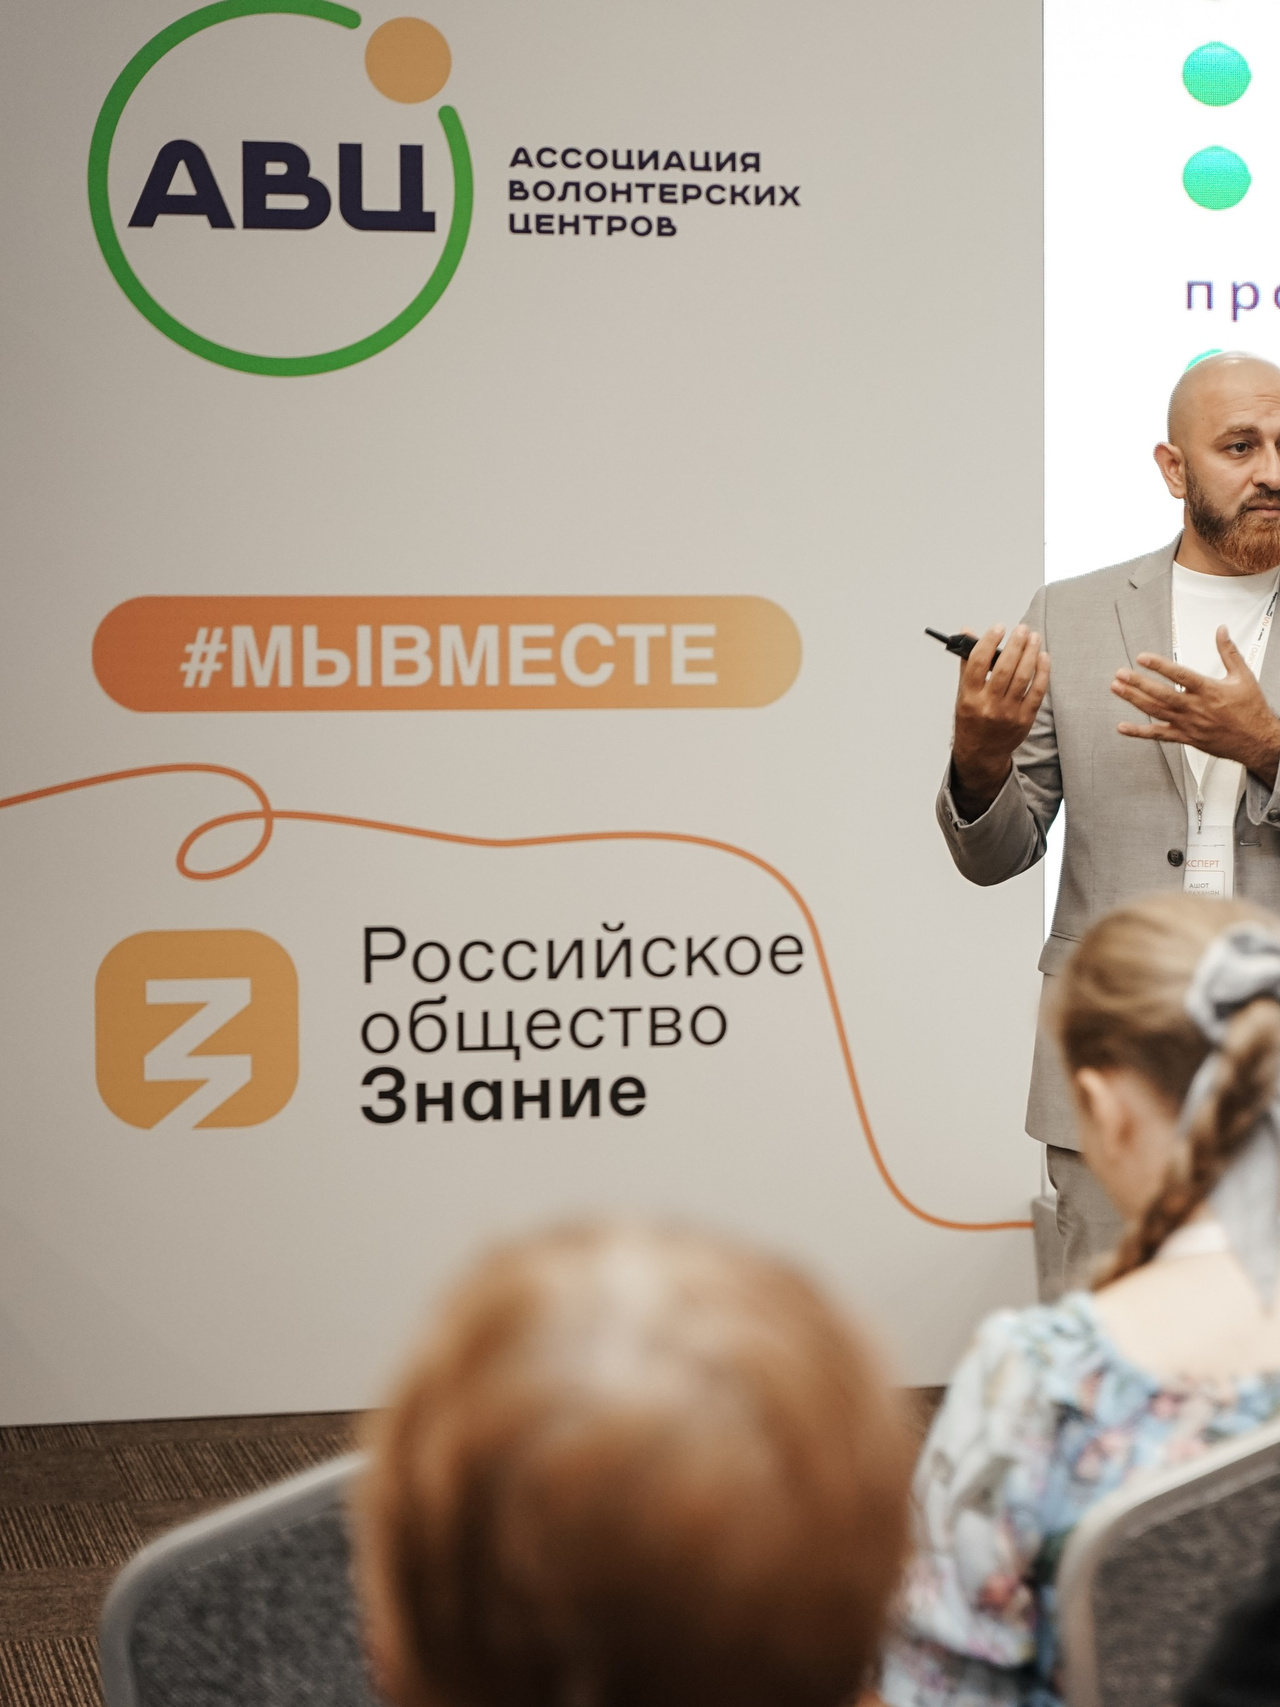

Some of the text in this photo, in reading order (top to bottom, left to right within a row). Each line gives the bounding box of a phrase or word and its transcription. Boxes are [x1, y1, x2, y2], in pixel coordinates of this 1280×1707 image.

[127, 139, 436, 232] АВЦ
[509, 146, 762, 174] АССОЦИАЦИЯ
[508, 179, 801, 207] ВОЛОНТЕРСКИХ
[509, 213, 677, 237] ЦЕНТРОВ
[180, 624, 719, 689] #МЫВМЕСТЕ
[363, 922, 805, 984] Российское
[360, 995, 728, 1061] общество
[360, 1066, 648, 1125] Знание
